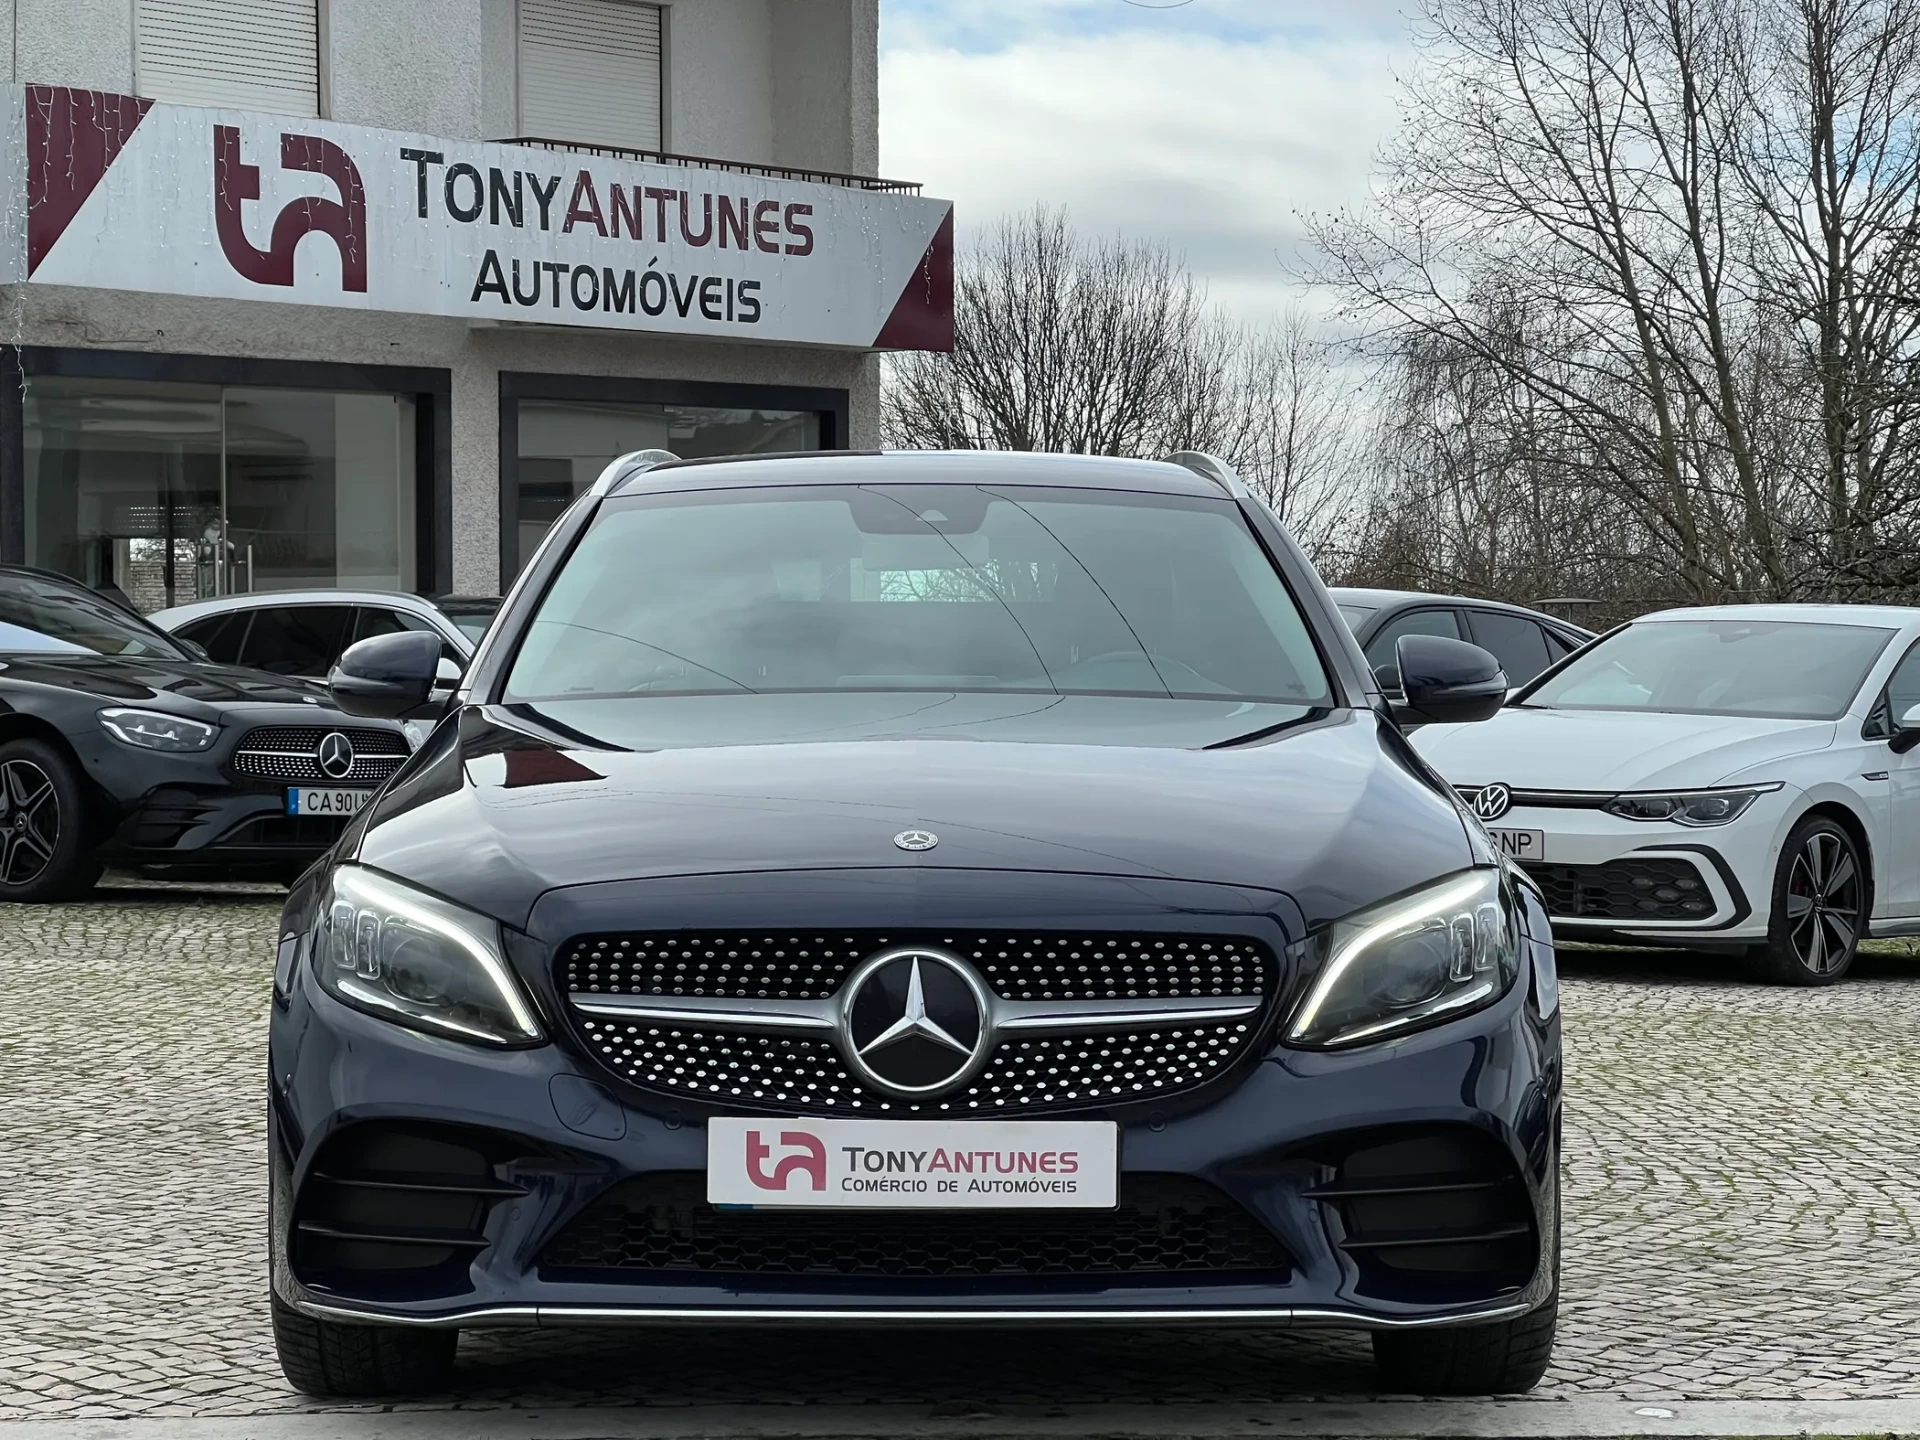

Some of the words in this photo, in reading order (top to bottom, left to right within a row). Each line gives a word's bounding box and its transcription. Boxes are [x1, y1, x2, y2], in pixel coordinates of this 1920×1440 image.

[470, 249, 761, 324] AUTOMÓVEIS
[1489, 832, 1532, 855] NP
[841, 1176, 928, 1193] COMÉRCIO
[937, 1180, 958, 1193] DE
[967, 1177, 1077, 1193] AUTOMÓVEIS
